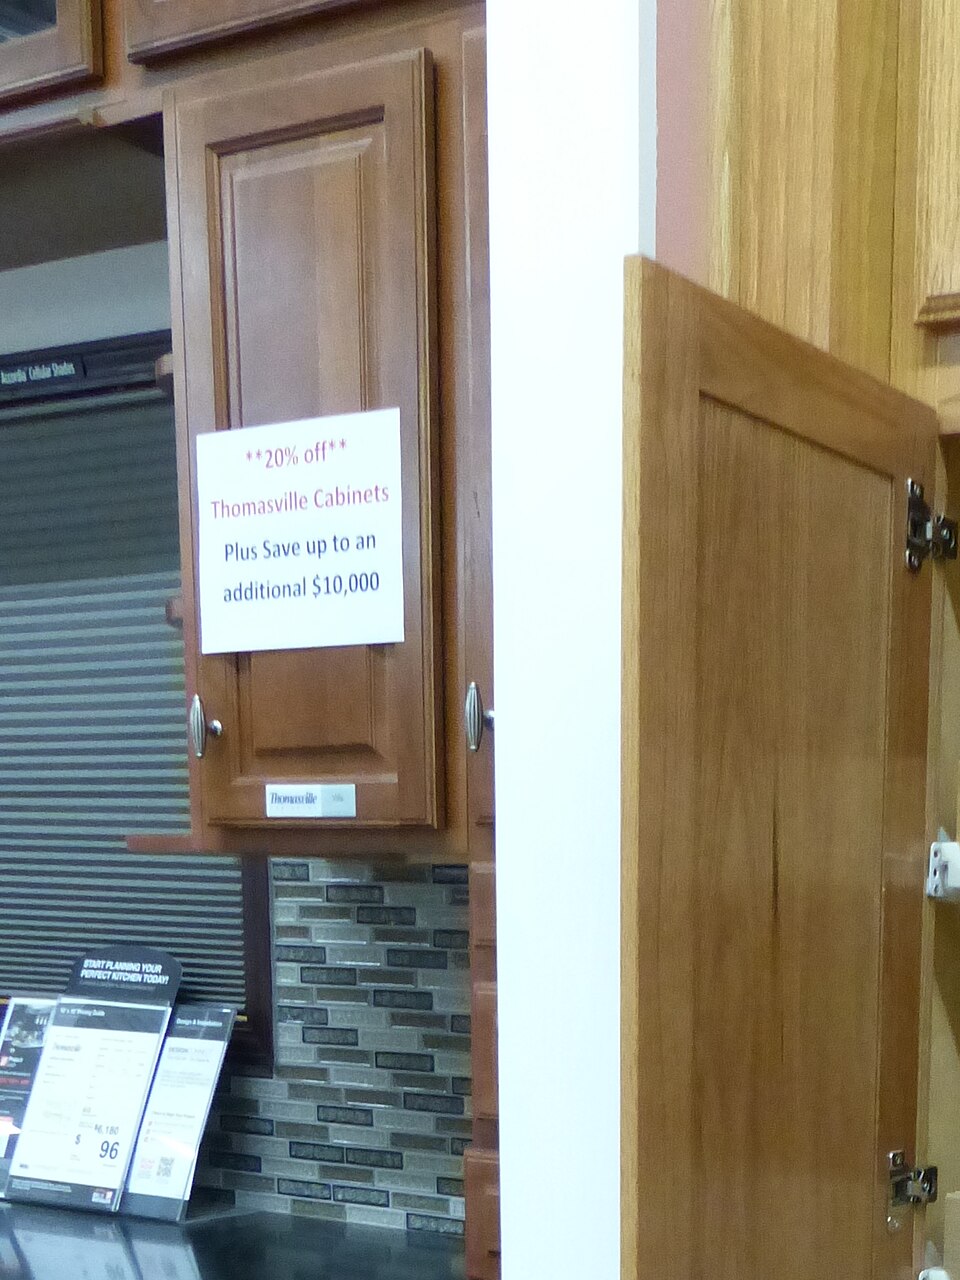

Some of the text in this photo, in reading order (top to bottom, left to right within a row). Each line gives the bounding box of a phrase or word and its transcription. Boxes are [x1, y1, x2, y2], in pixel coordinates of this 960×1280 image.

[211, 484, 389, 519] Thomasville Cabinets
[224, 534, 376, 562] Plus Save up to an
[223, 571, 380, 602] additional $10,000
[271, 792, 317, 805] Thomasville
[83, 959, 162, 974] START PLANNING YOUR
[80, 969, 170, 985] PERFECT KITCHEN TODAY!
[99, 1140, 120, 1160] 96
